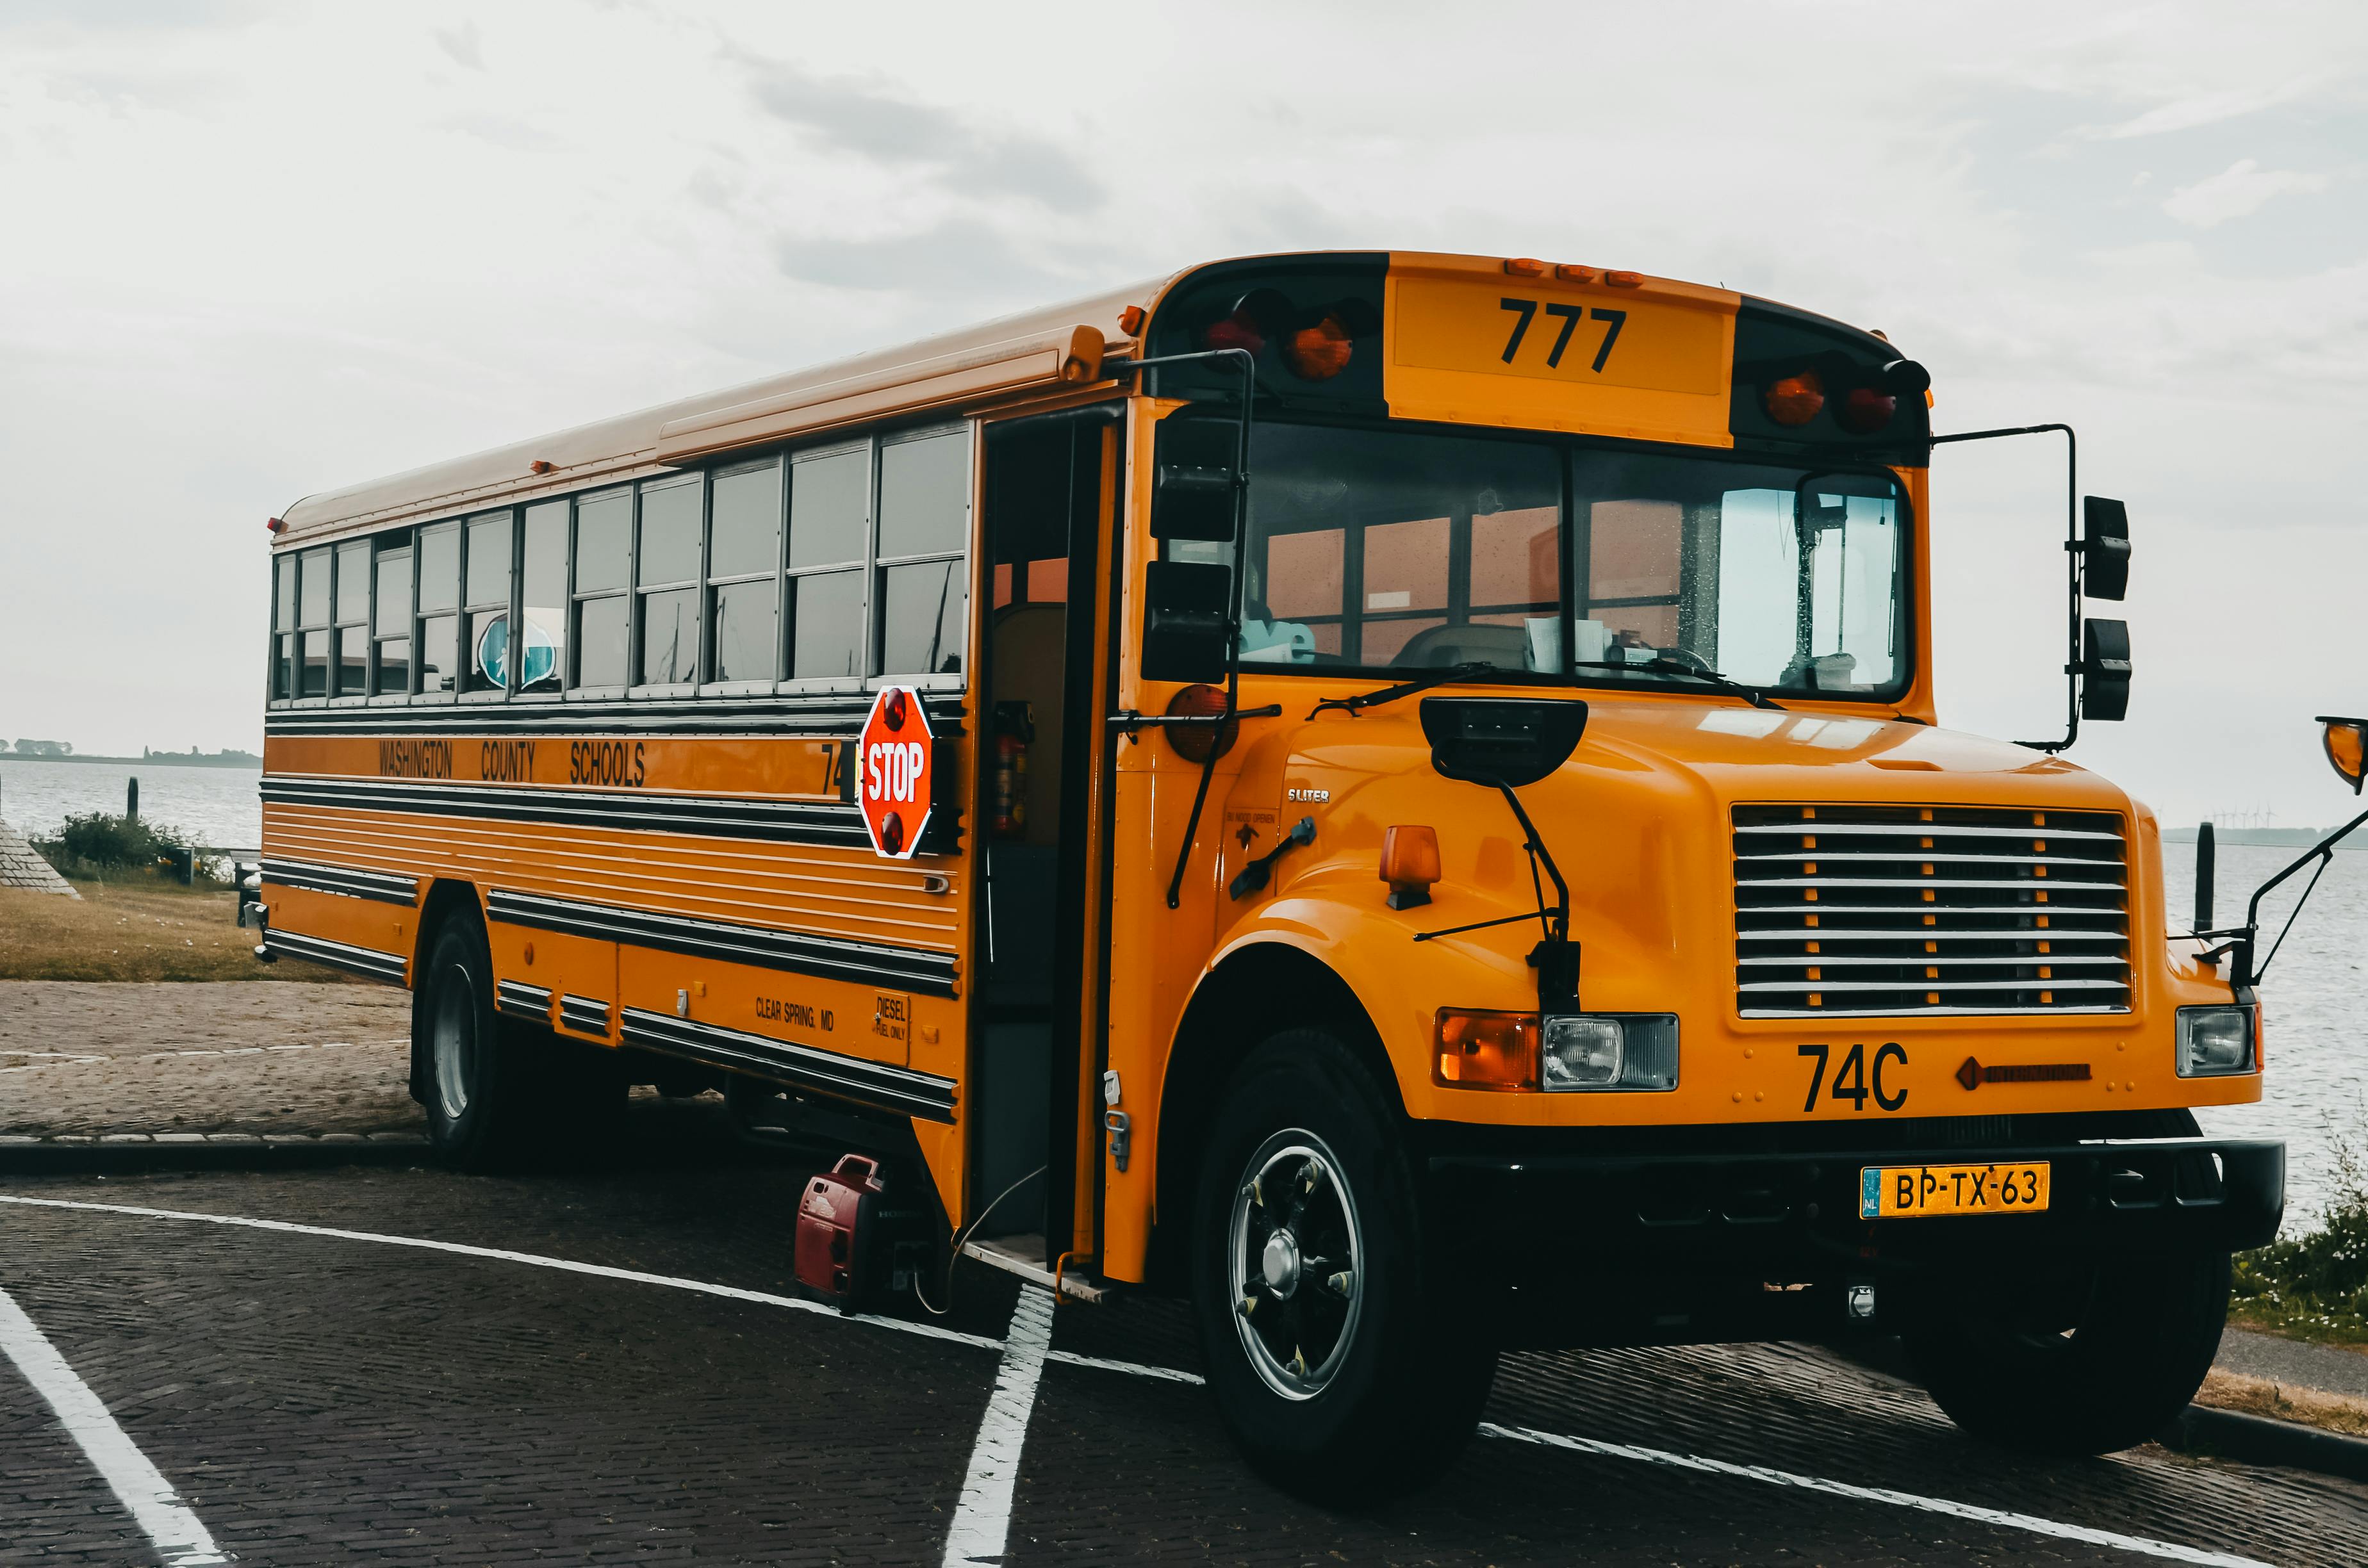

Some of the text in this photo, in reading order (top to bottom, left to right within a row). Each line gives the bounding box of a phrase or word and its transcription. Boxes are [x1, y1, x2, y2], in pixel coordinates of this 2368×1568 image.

[1500, 297, 1627, 374] 777
[379, 740, 645, 787] WASHINGTON COUNTY SCHOOLS
[868, 742, 925, 803] STOP
[756, 996, 782, 1021] CLEAR
[821, 1009, 834, 1032] MD
[876, 996, 905, 1022] DIESEL
[891, 1025, 905, 1041] ONLY
[1797, 1042, 1909, 1113] 74C
[1863, 1170, 2037, 1211] NL BP-TX-63
